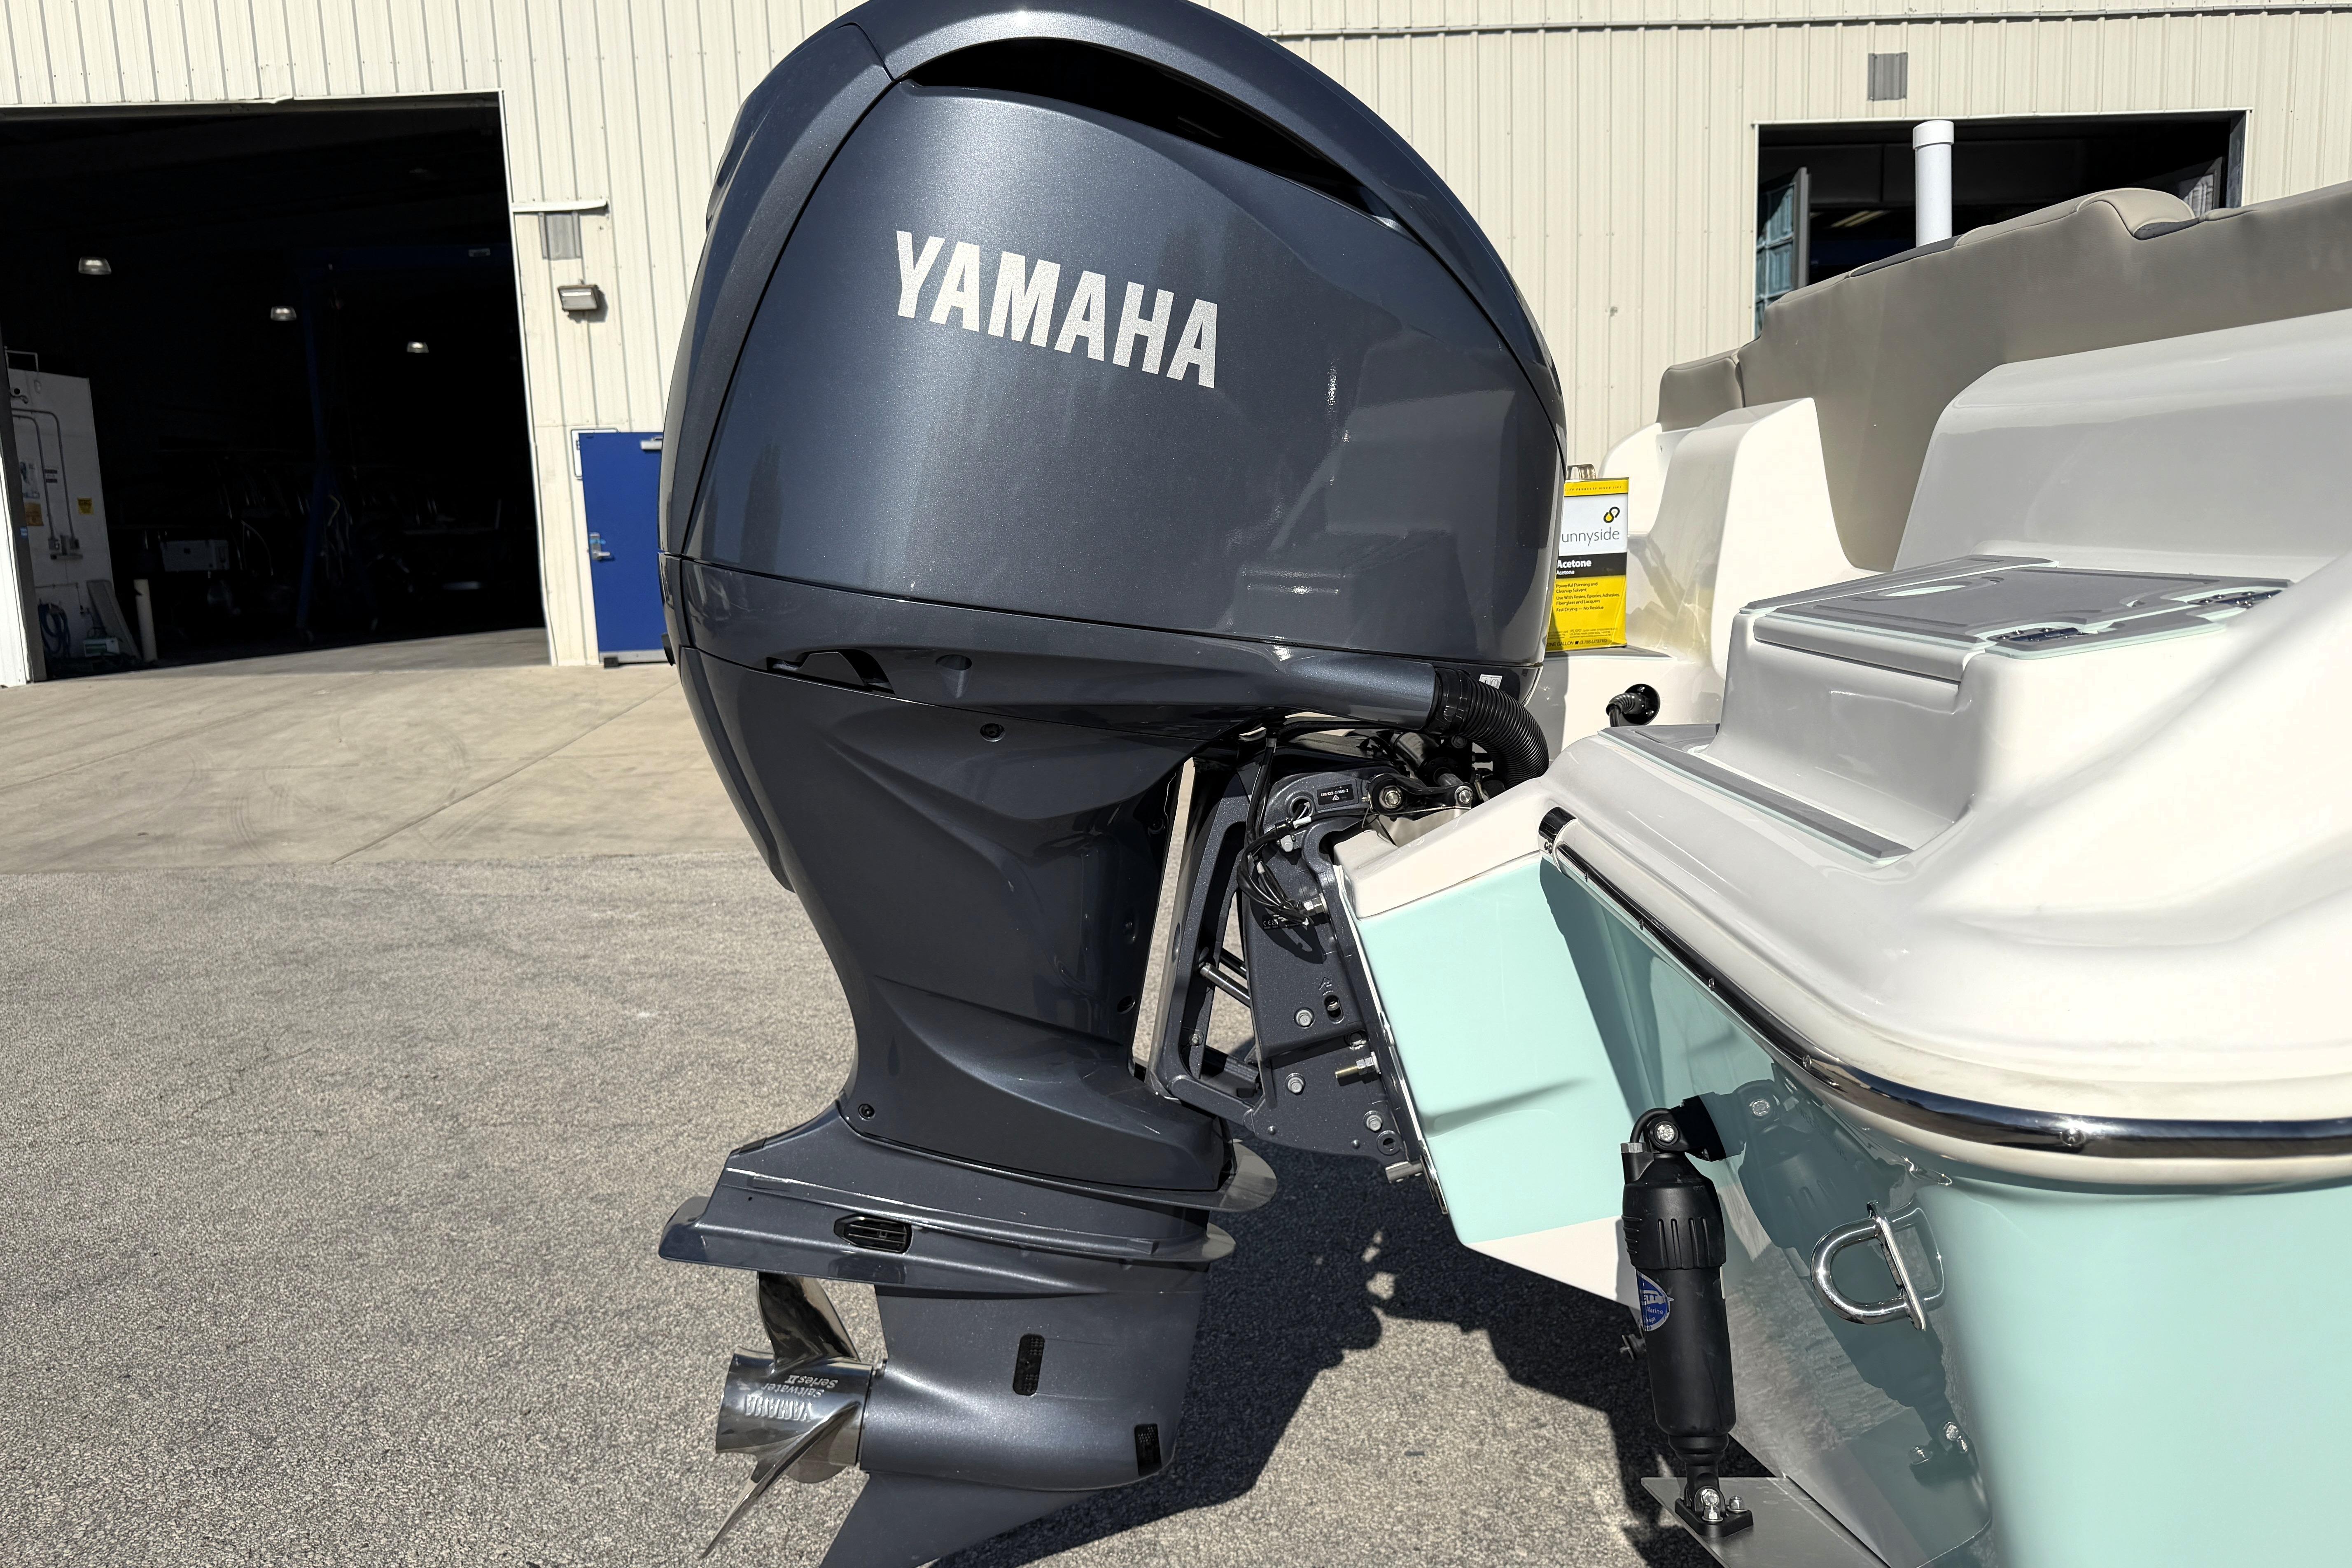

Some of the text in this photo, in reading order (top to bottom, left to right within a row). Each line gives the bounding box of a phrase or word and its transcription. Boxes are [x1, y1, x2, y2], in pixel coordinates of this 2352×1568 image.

[896, 230, 1218, 389] YAMAHA
[1562, 527, 1620, 546] unnyside
[1557, 560, 1592, 569] Acetone
[1643, 1293, 1658, 1301] ETT
[797, 1376, 838, 1388] Series
[761, 1383, 824, 1398] Saltwater
[745, 1394, 812, 1422] YAMAHA
